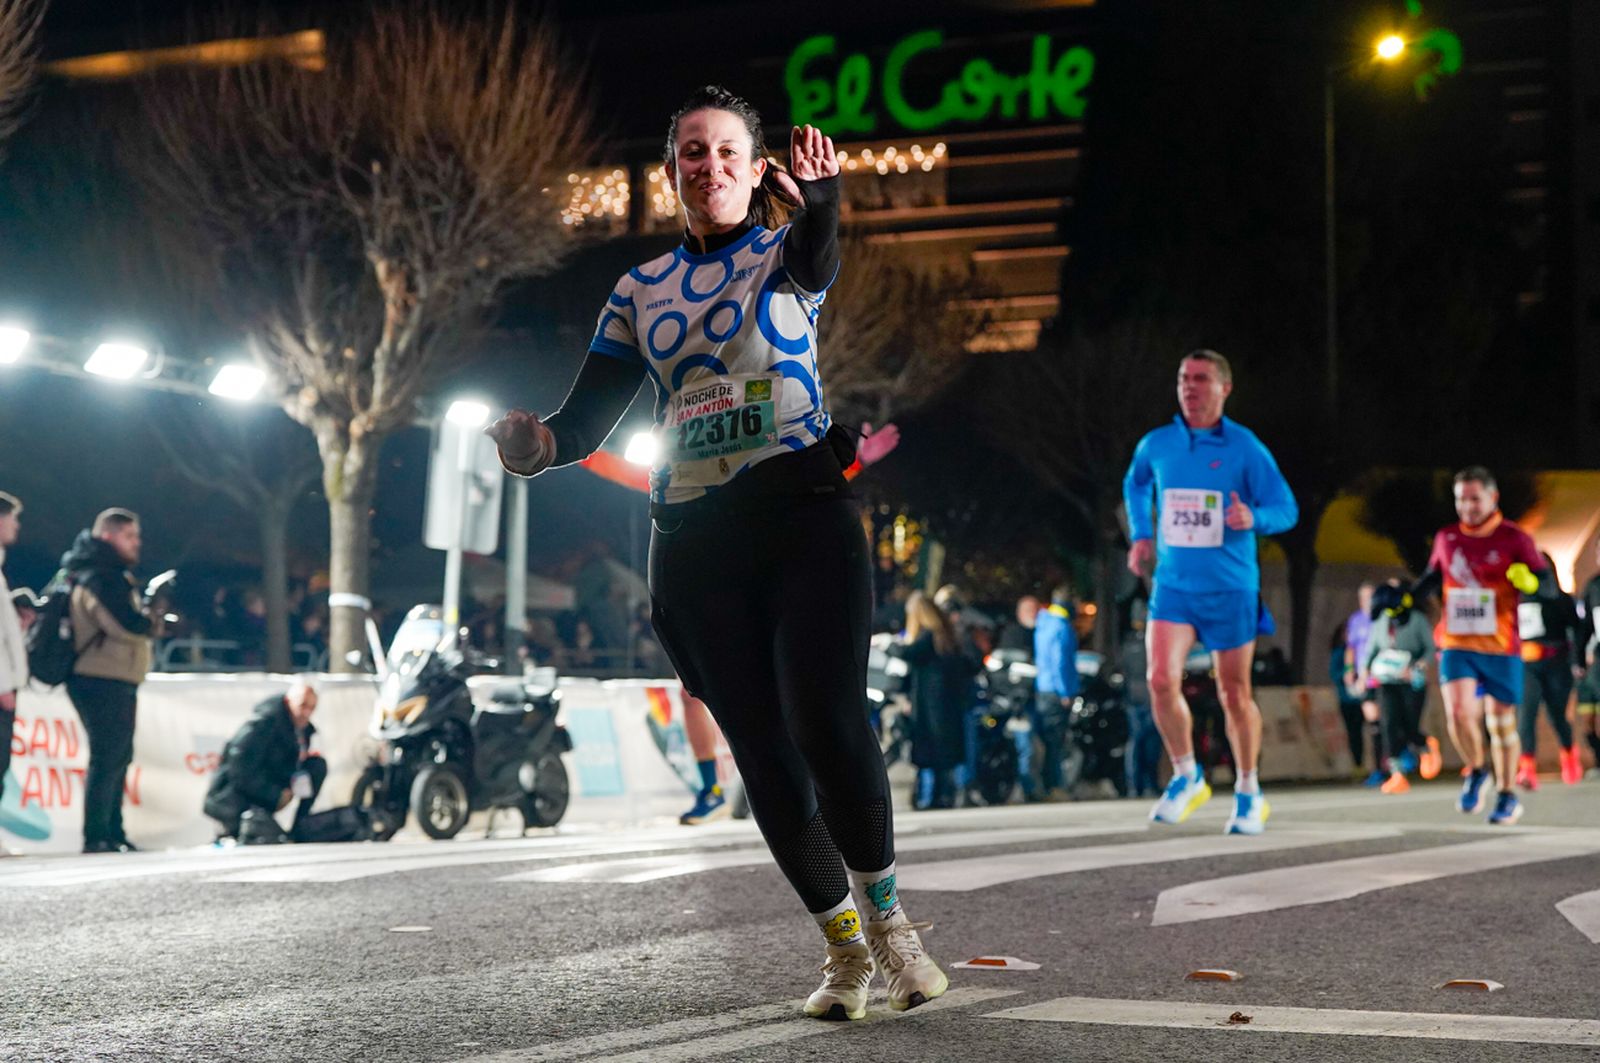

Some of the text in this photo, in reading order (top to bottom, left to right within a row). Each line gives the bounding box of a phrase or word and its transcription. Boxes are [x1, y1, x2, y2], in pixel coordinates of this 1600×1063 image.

[785, 29, 1096, 136] El Corte
[684, 387, 717, 408] NOCHE
[719, 385, 734, 397] DE
[695, 396, 734, 416] ANTÓN
[677, 403, 762, 450] 12376
[10, 716, 79, 759] SAN
